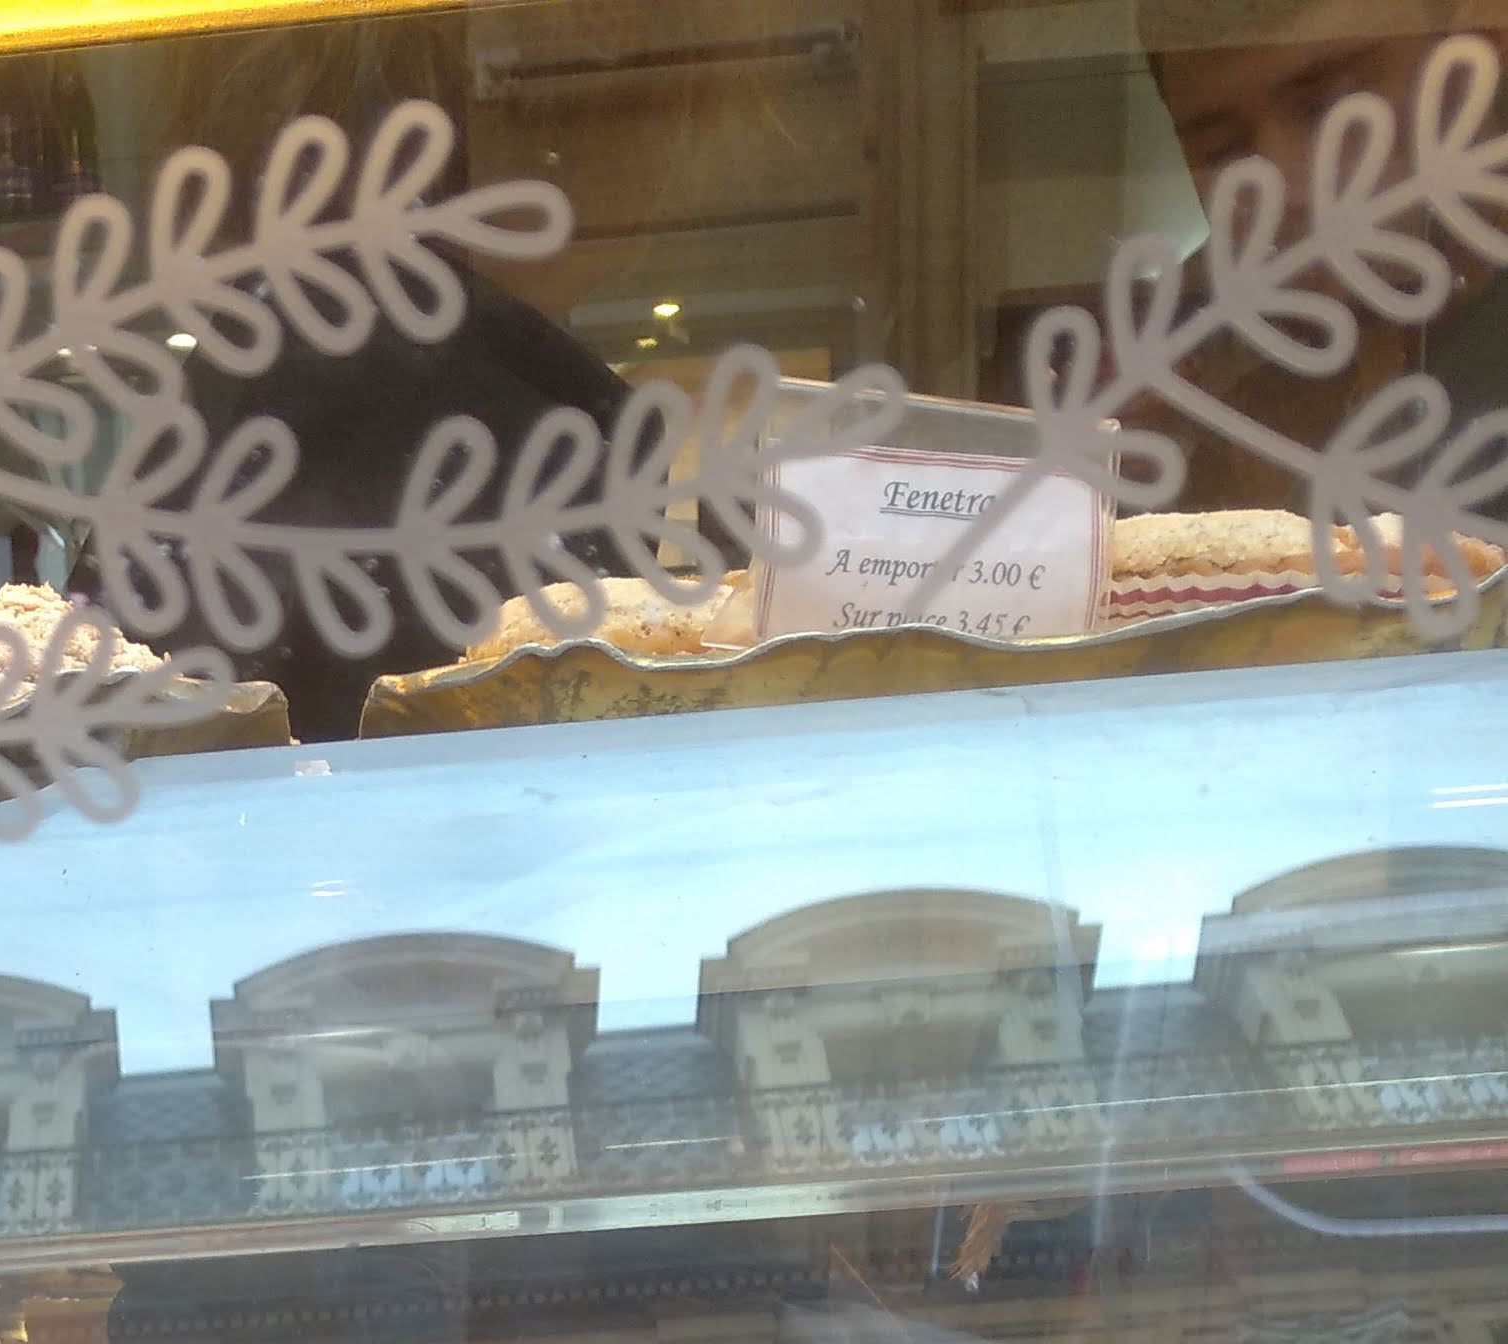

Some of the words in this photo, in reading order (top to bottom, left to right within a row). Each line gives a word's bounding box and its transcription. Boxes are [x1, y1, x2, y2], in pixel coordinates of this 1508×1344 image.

[825, 549, 851, 576] A
[858, 556, 964, 587] emporr
[967, 560, 1023, 588] 3.00
[1028, 565, 1046, 590] €
[833, 602, 883, 628] Sur
[958, 610, 1009, 635] 3.45
